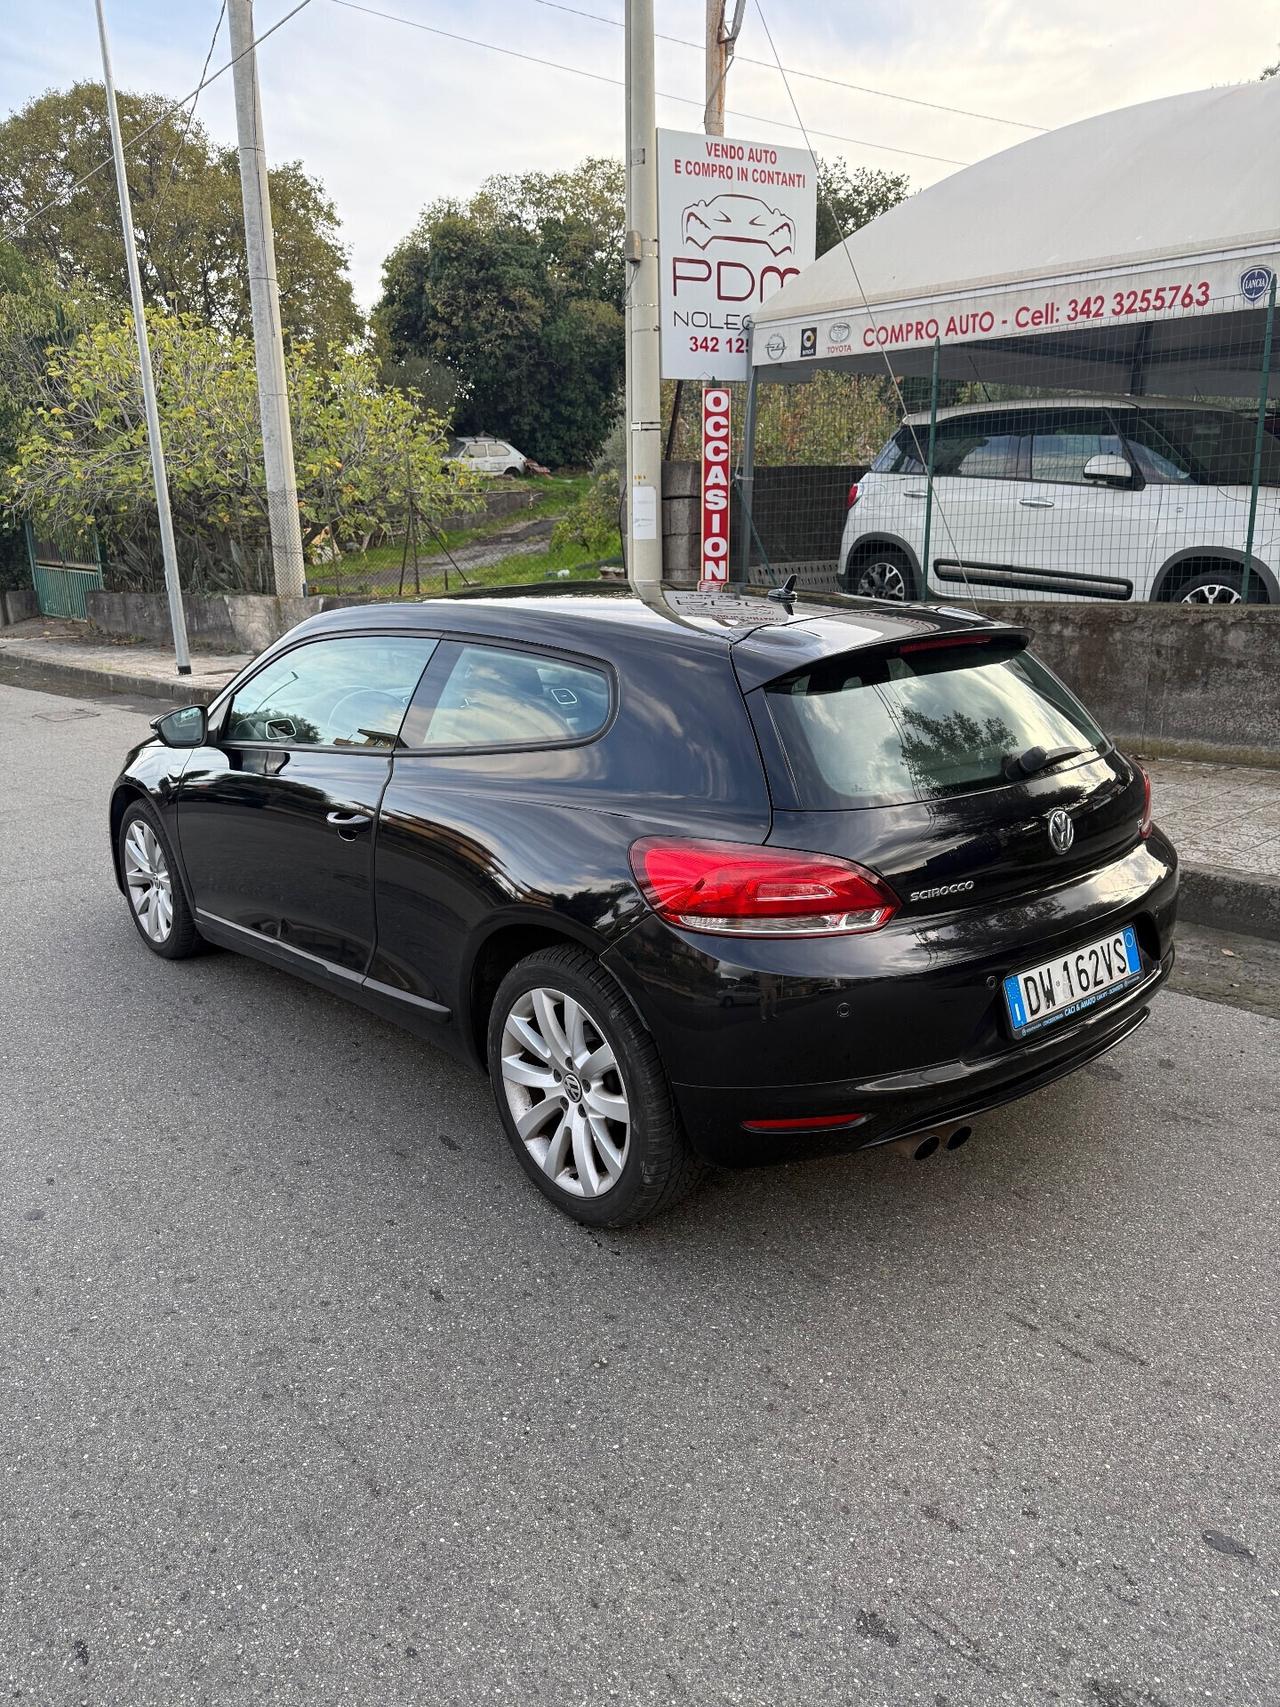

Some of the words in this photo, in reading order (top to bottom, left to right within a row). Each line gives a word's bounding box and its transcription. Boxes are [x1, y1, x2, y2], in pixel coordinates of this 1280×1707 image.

[706, 142, 744, 160] VENDO
[748, 148, 777, 165] AUTO
[674, 159, 681, 174] E
[685, 161, 733, 180] COMPRO
[737, 166, 748, 182] IN
[752, 169, 806, 188] CONTANTI
[863, 319, 939, 347] COMPRO
[945, 311, 995, 336] AUTO
[1015, 302, 1060, 328] Cell:
[1066, 295, 1105, 322] 342
[1111, 281, 1210, 317] 3255763
[689, 336, 719, 352] 342
[827, 344, 852, 354] TOYOTA
[704, 391, 728, 580] OCCASION
[910, 880, 975, 902] SCIROCCO
